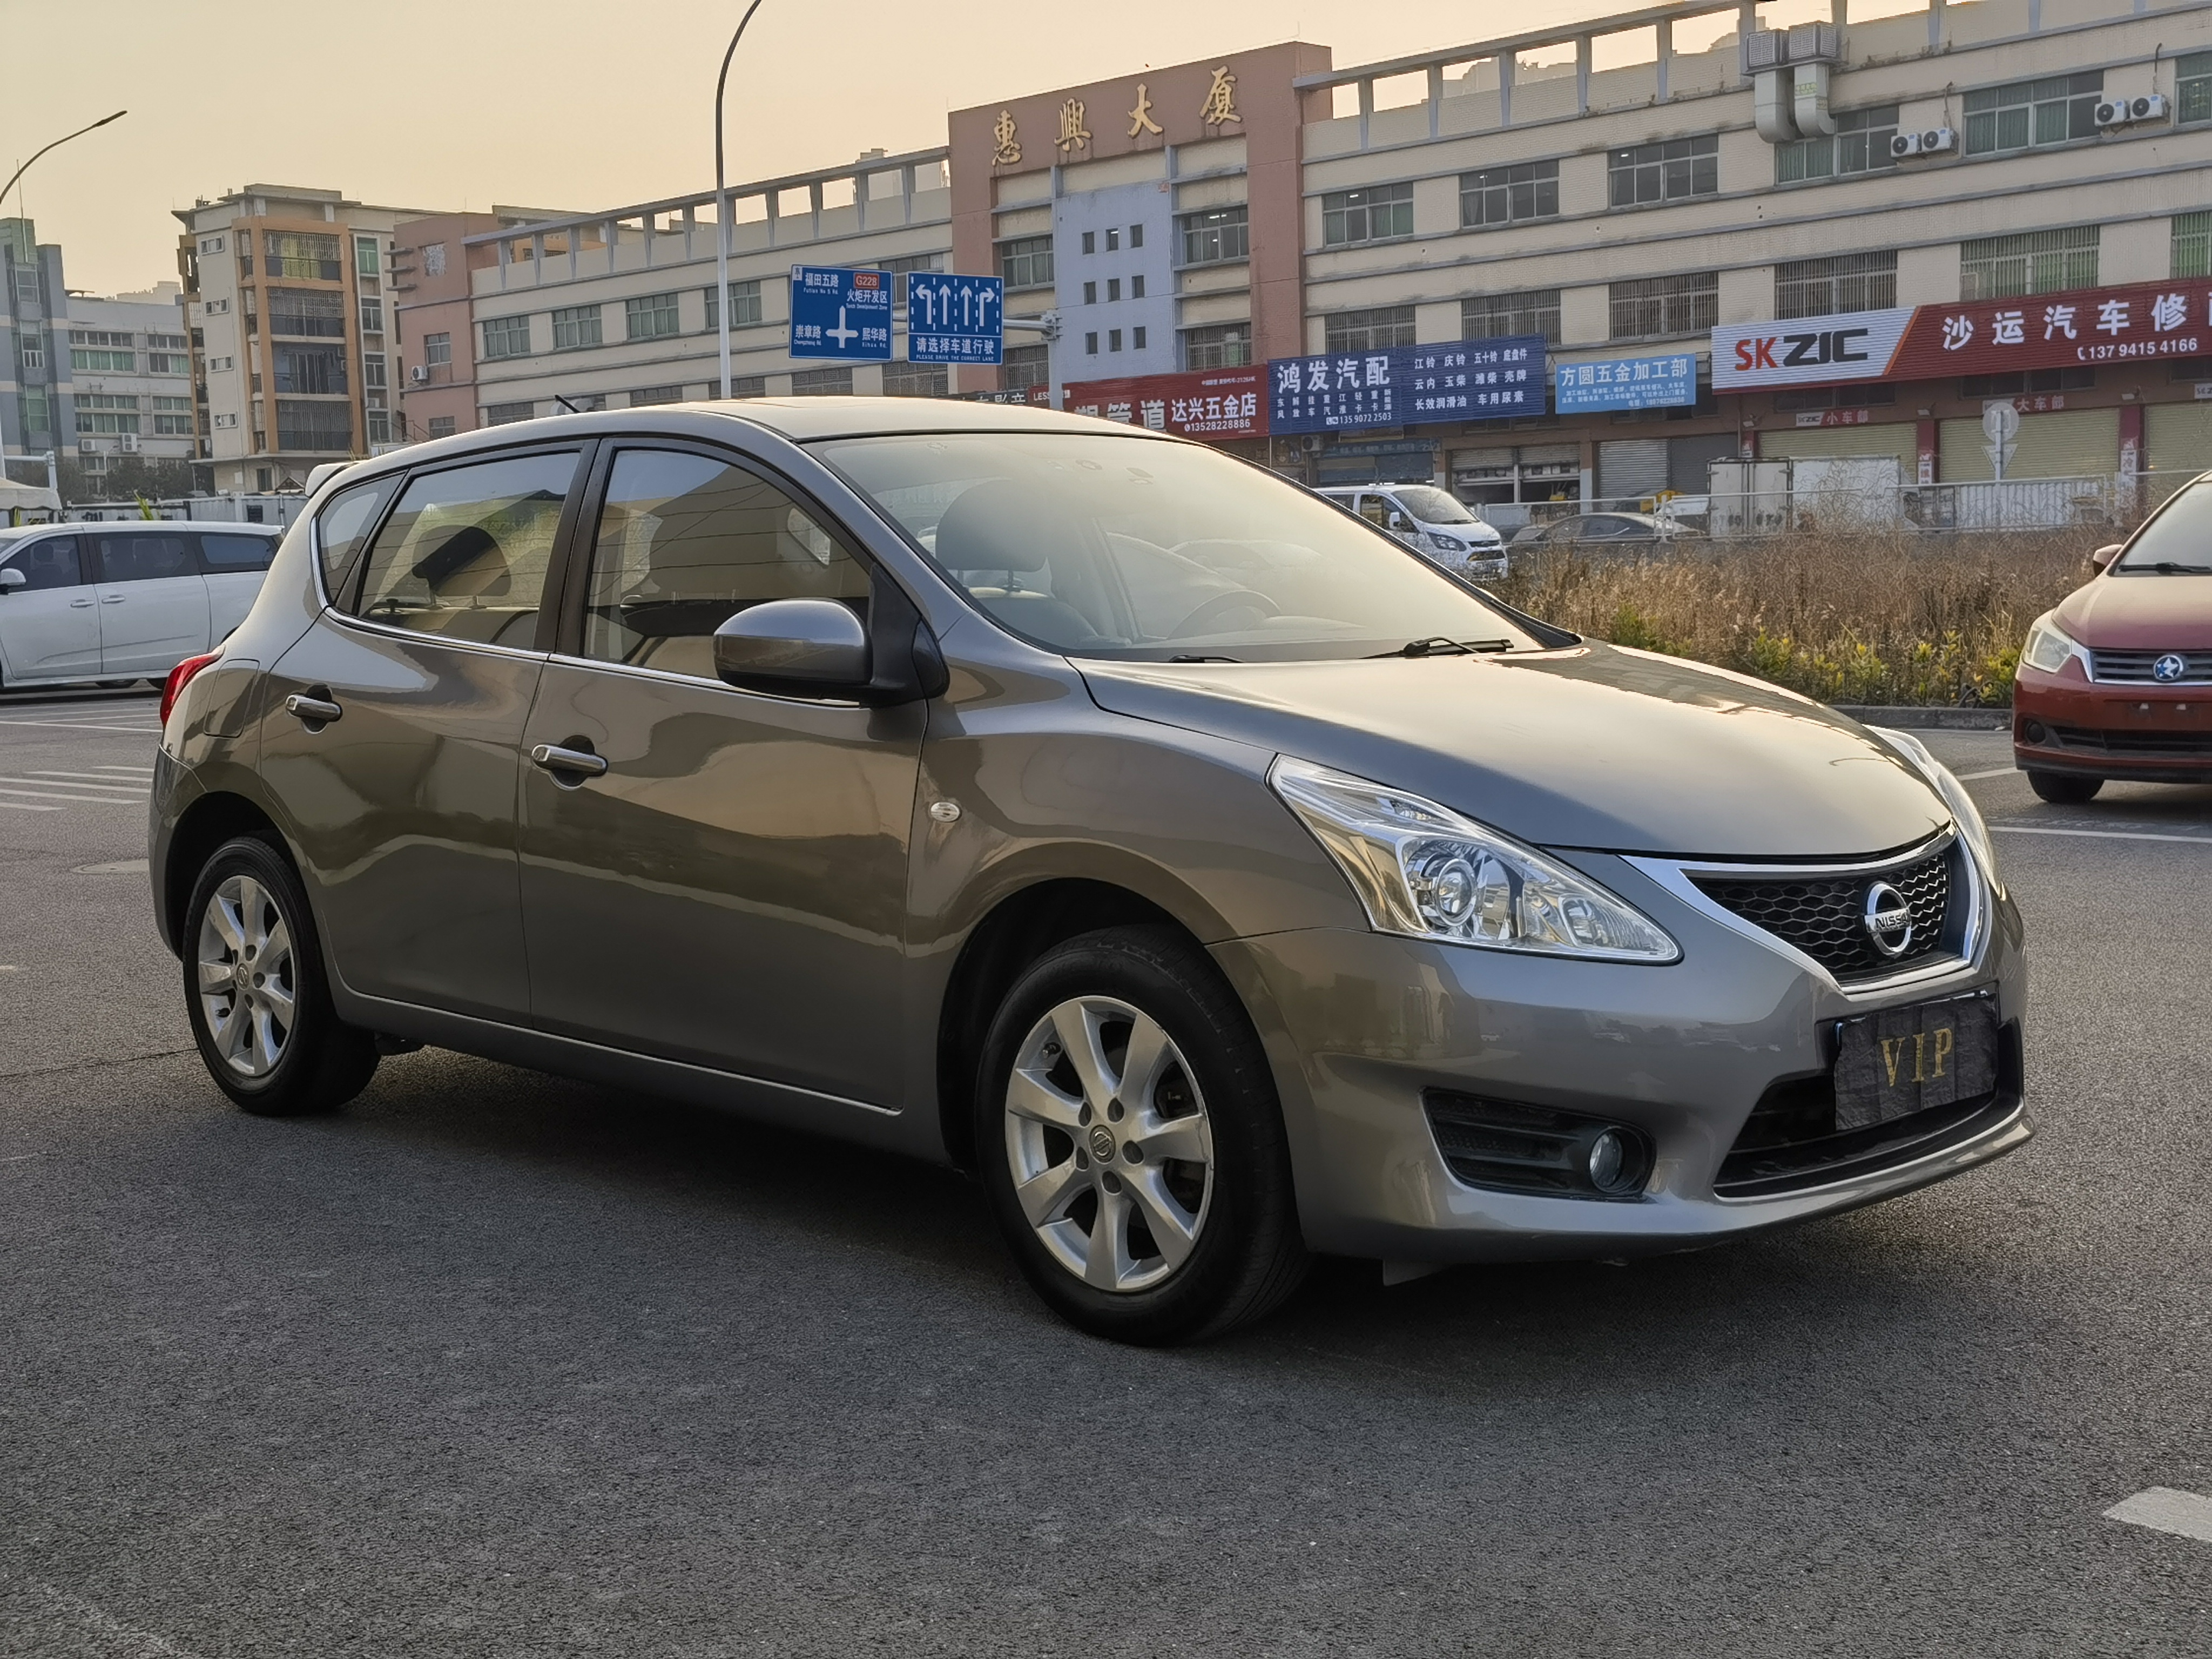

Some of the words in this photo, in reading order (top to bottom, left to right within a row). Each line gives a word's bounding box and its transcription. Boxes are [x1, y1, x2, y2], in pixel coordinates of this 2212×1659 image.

[805, 272, 839, 287] 福田五路
[855, 275, 878, 286] G228
[847, 289, 888, 304] 火炬开发区
[1941, 292, 2212, 350] 沙运汽车修
[916, 336, 994, 354] 请选择车道行驶
[1735, 337, 1778, 370] SK
[1783, 328, 1868, 367] ZIC
[2089, 345, 2115, 359] 137
[2119, 341, 2156, 356] 9415
[2160, 338, 2197, 353] 4166
[1414, 356, 1435, 369] 江铃
[1444, 354, 1466, 367] 庆铃
[1474, 351, 1498, 364] 五十铃
[1503, 348, 1527, 361] 底盘件
[1278, 356, 1390, 394] 鸿发汽配
[1415, 377, 1435, 390] 云内
[1445, 374, 1466, 387] 玉柴
[1505, 369, 1527, 382] 壳牌
[1560, 358, 1687, 386] 方圆五金加工部
[1171, 392, 1257, 422] 达兴五金店
[1277, 398, 1285, 419] 东风
[1355, 392, 1363, 413] 轻卡
[1415, 395, 1467, 410] 长效润滑油
[1478, 390, 1524, 405] 车用尿素
[2017, 395, 2064, 412] 大车部
[1191, 419, 1251, 431] 13528228886
[1354, 414, 1372, 423] 9072
[1373, 413, 1392, 422] 2503
[1826, 410, 1869, 425] 小车部
[1880, 1027, 1953, 1087] VIP
